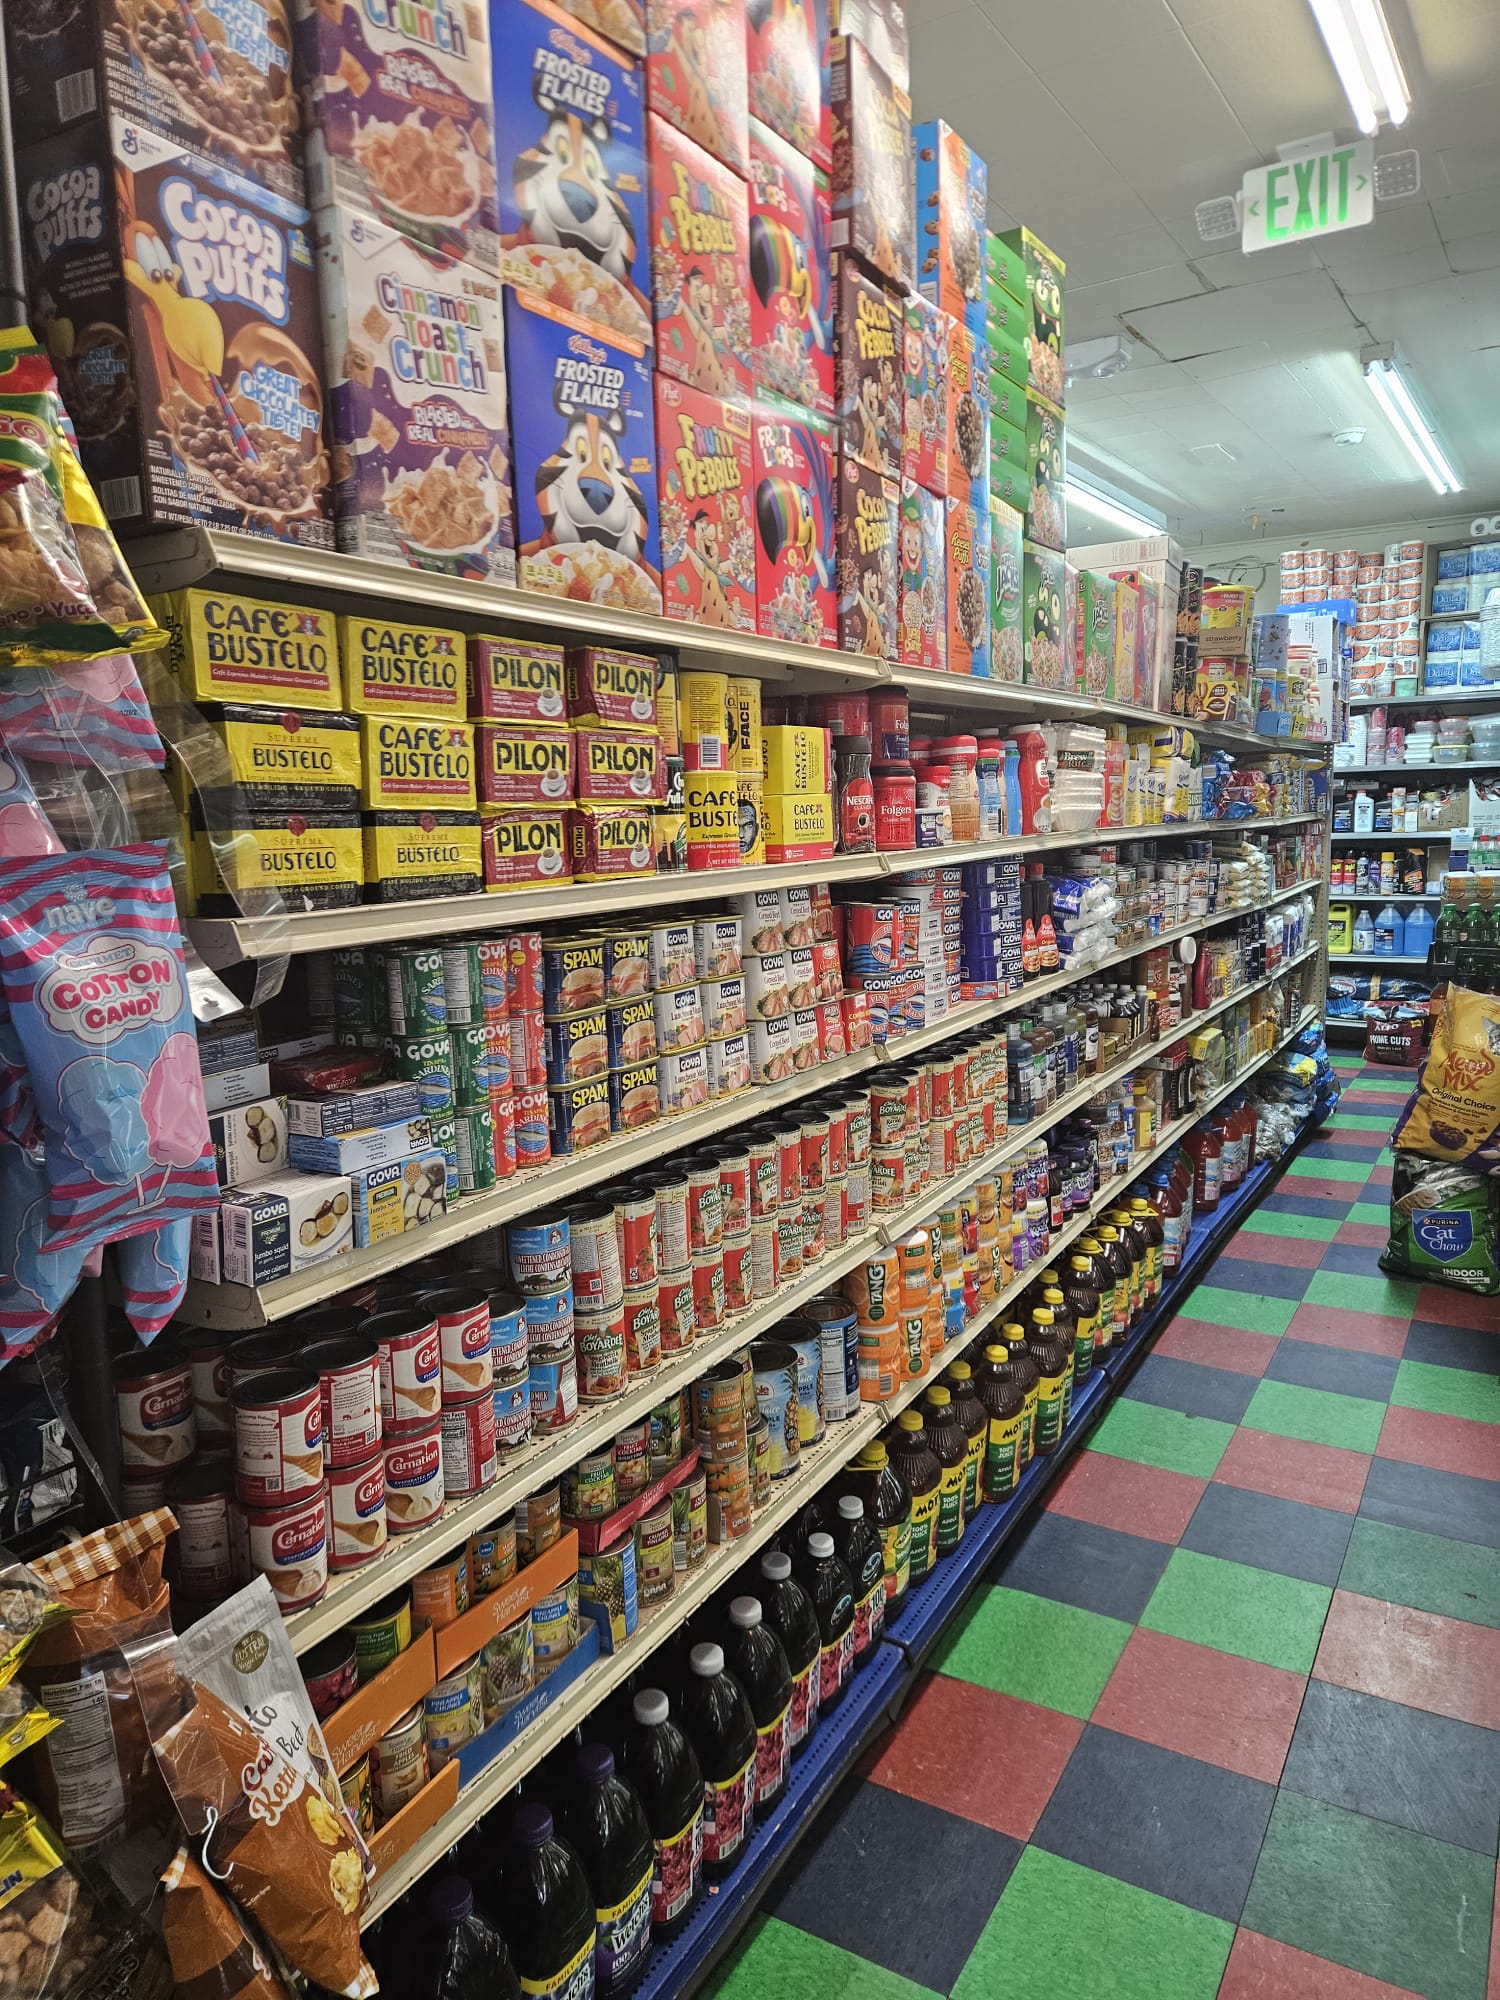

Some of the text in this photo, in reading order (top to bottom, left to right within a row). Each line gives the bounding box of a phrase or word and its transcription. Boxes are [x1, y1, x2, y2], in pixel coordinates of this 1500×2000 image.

[534, 48, 612, 96] FROSTED
[540, 74, 606, 117] FLAKES
[1265, 149, 1356, 240] EXIT
[380, 277, 481, 326] Cinnamon
[402, 311, 469, 354] Toast
[392, 336, 487, 393] Crunch
[555, 358, 625, 388] FROSTED
[254, 363, 302, 396] GREAT
[240, 371, 321, 433] CHOCOLATEY
[560, 380, 620, 410] FLAKES
[414, 404, 461, 428] BLASTED
[408, 425, 437, 444] REAL
[150, 465, 186, 479] NATURALLY
[151, 475, 188, 488] SWEETENED
[676, 448, 741, 501] PEBBLES
[152, 486, 179, 498] BOLITAS
[154, 495, 168, 505] CON
[168, 498, 188, 509] SABOR
[155, 511, 167, 519] NET
[204, 601, 293, 638] CAFÉ
[361, 626, 433, 658] CAFÉ
[206, 631, 327, 673] BUSTELO
[362, 654, 457, 689] BUSTELO
[493, 656, 561, 691] PILON
[596, 663, 652, 697] PILON
[740, 701, 750, 750] FACE
[379, 724, 445, 752] CAFÉ
[253, 747, 333, 771] BUSTELO
[380, 752, 469, 779] BUSTELO
[496, 742, 567, 771] PILON
[591, 744, 654, 772] PILON
[1064, 752, 1089, 762] Brew
[881, 805, 912, 816] Folgers
[599, 819, 650, 847] PILON
[794, 817, 825, 830] BUSTELO
[497, 822, 561, 853] PILON
[260, 851, 336, 872] BUSTELO
[397, 847, 459, 864] BUSTELO
[943, 870, 960, 881] GOYA
[1003, 865, 1020, 873] GOYA
[757, 892, 779, 905] GOYA
[789, 888, 809, 900] GOYA
[667, 932, 688, 945] GOYA
[717, 925, 736, 938] GOYA
[1002, 934, 1021, 944] GOYA
[613, 939, 649, 959] SPAM
[792, 950, 812, 962] GOYA
[563, 948, 603, 971] SPAM
[763, 955, 784, 968] GOYA
[53, 959, 172, 1009] COTTON
[721, 984, 740, 997] GOYA
[864, 980, 890, 991] GOYA
[675, 993, 696, 1007] GOYA
[85, 991, 161, 1030] CANDY
[622, 999, 654, 1025] SPAM
[796, 1010, 815, 1024] GOYA
[568, 1014, 606, 1039] SPAM
[769, 1020, 790, 1033] GOYA
[726, 1043, 744, 1055] GOYA
[1390, 1036, 1411, 1046] CUTS
[679, 1056, 701, 1070] GOYA
[621, 1066, 657, 1090] SPAM
[572, 1082, 608, 1108] SPAM
[1432, 1087, 1497, 1112] Original Choice
[410, 1137, 429, 1148] GOYA
[368, 1166, 400, 1187] GOYA
[375, 1188, 396, 1199] PREMIUM
[254, 1203, 288, 1221] GOYA
[1420, 1225, 1457, 1240] Cat
[254, 1243, 289, 1262] Jumbo squid
[1428, 1237, 1464, 1251] Chow
[1442, 1268, 1484, 1277] INDOOR
[869, 1265, 885, 1305] TANG
[579, 1333, 623, 1352] BOYARDEE
[908, 1319, 922, 1358] TANG
[536, 1392, 548, 1400] MILK
[998, 1451, 1014, 1459] JUICE
[999, 1445, 1014, 1453] 100%
[388, 1449, 438, 1474] Carnation
[942, 1500, 959, 1509] JUICE
[943, 1495, 959, 1503] 100%
[910, 1524, 928, 1533] 100%
[910, 1530, 928, 1538] JUICE
[909, 1546, 926, 1554] APPLE
[276, 1720, 304, 1759] Beet
[612, 1893, 637, 1919] FAMILY
[545, 1961, 575, 1992] FAMILY
